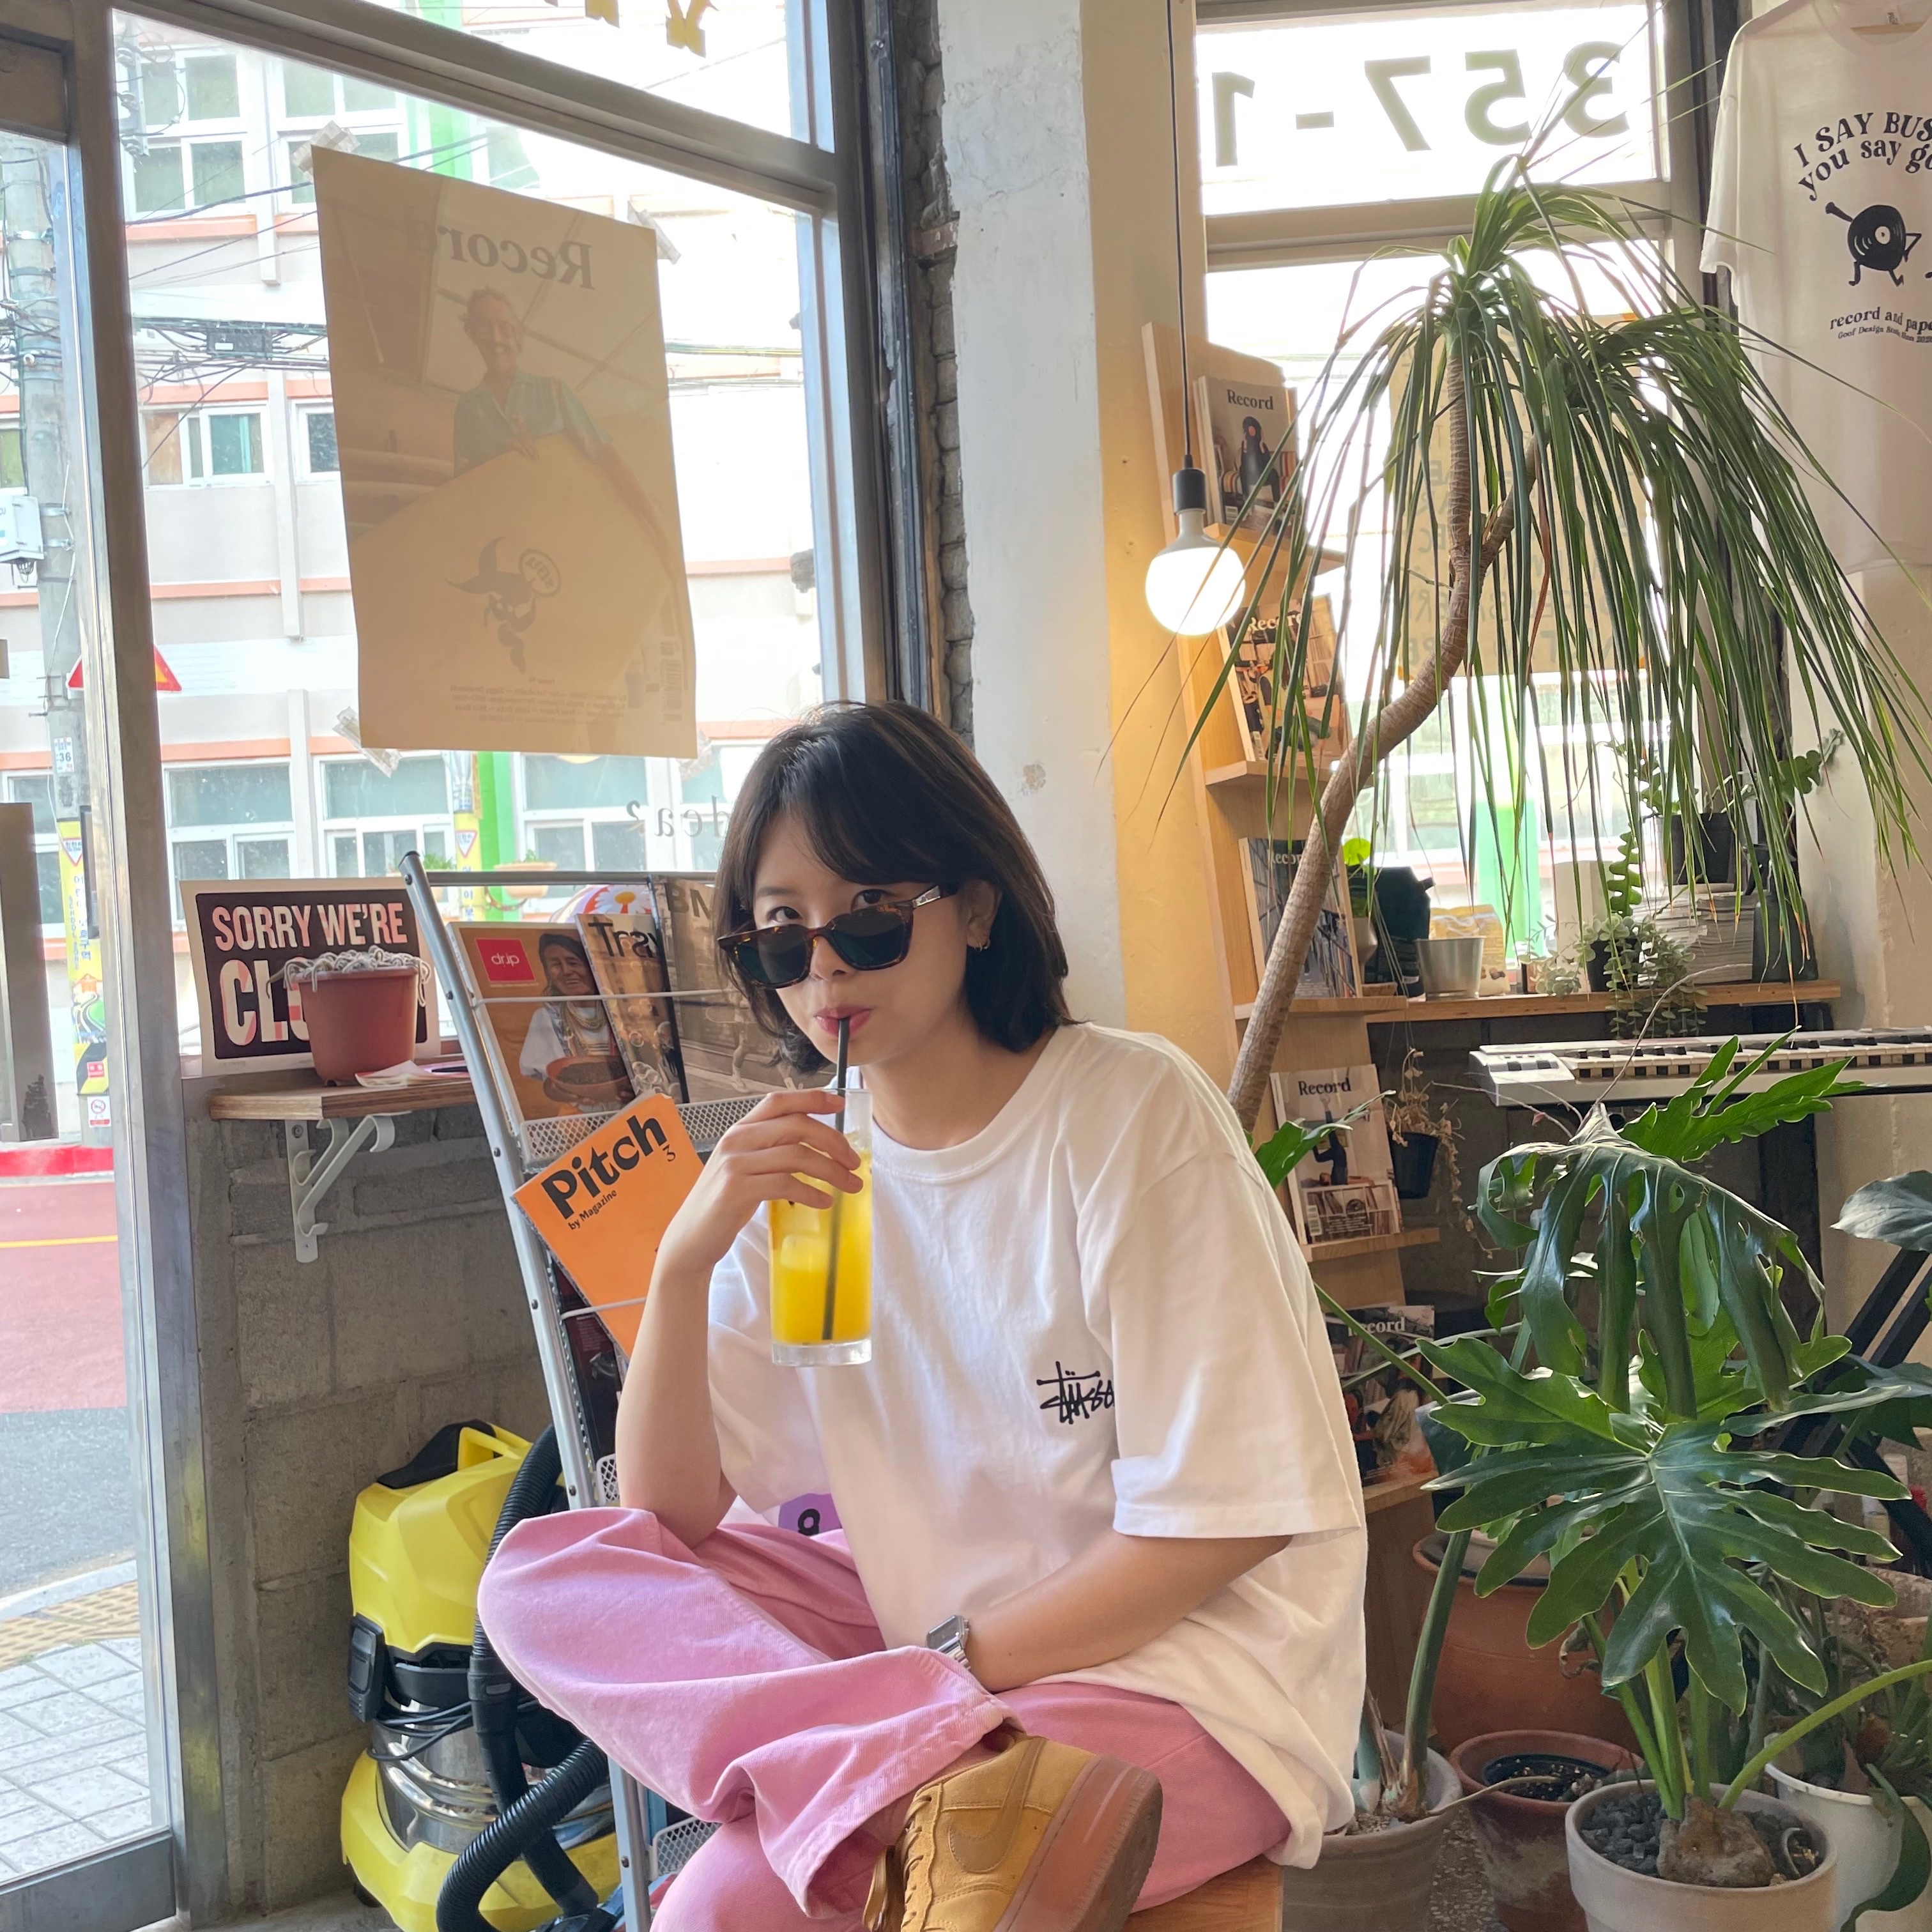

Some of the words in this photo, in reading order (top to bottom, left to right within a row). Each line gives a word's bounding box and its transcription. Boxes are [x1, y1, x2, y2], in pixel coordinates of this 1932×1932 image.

[1794, 143, 1809, 167] I
[1816, 112, 1874, 152] SAY
[1798, 149, 1850, 201] you
[1860, 140, 1901, 165] say
[1830, 307, 1880, 329] record
[1227, 389, 1274, 410] Record
[1247, 613, 1302, 631] Recr
[212, 905, 311, 951] SORRY
[317, 903, 408, 946] WE'RE
[1298, 1077, 1351, 1096] Record
[541, 1115, 667, 1220] Pitch
[663, 1144, 676, 1162] 3
[568, 1219, 581, 1230] by
[579, 1190, 617, 1222] Magazine
